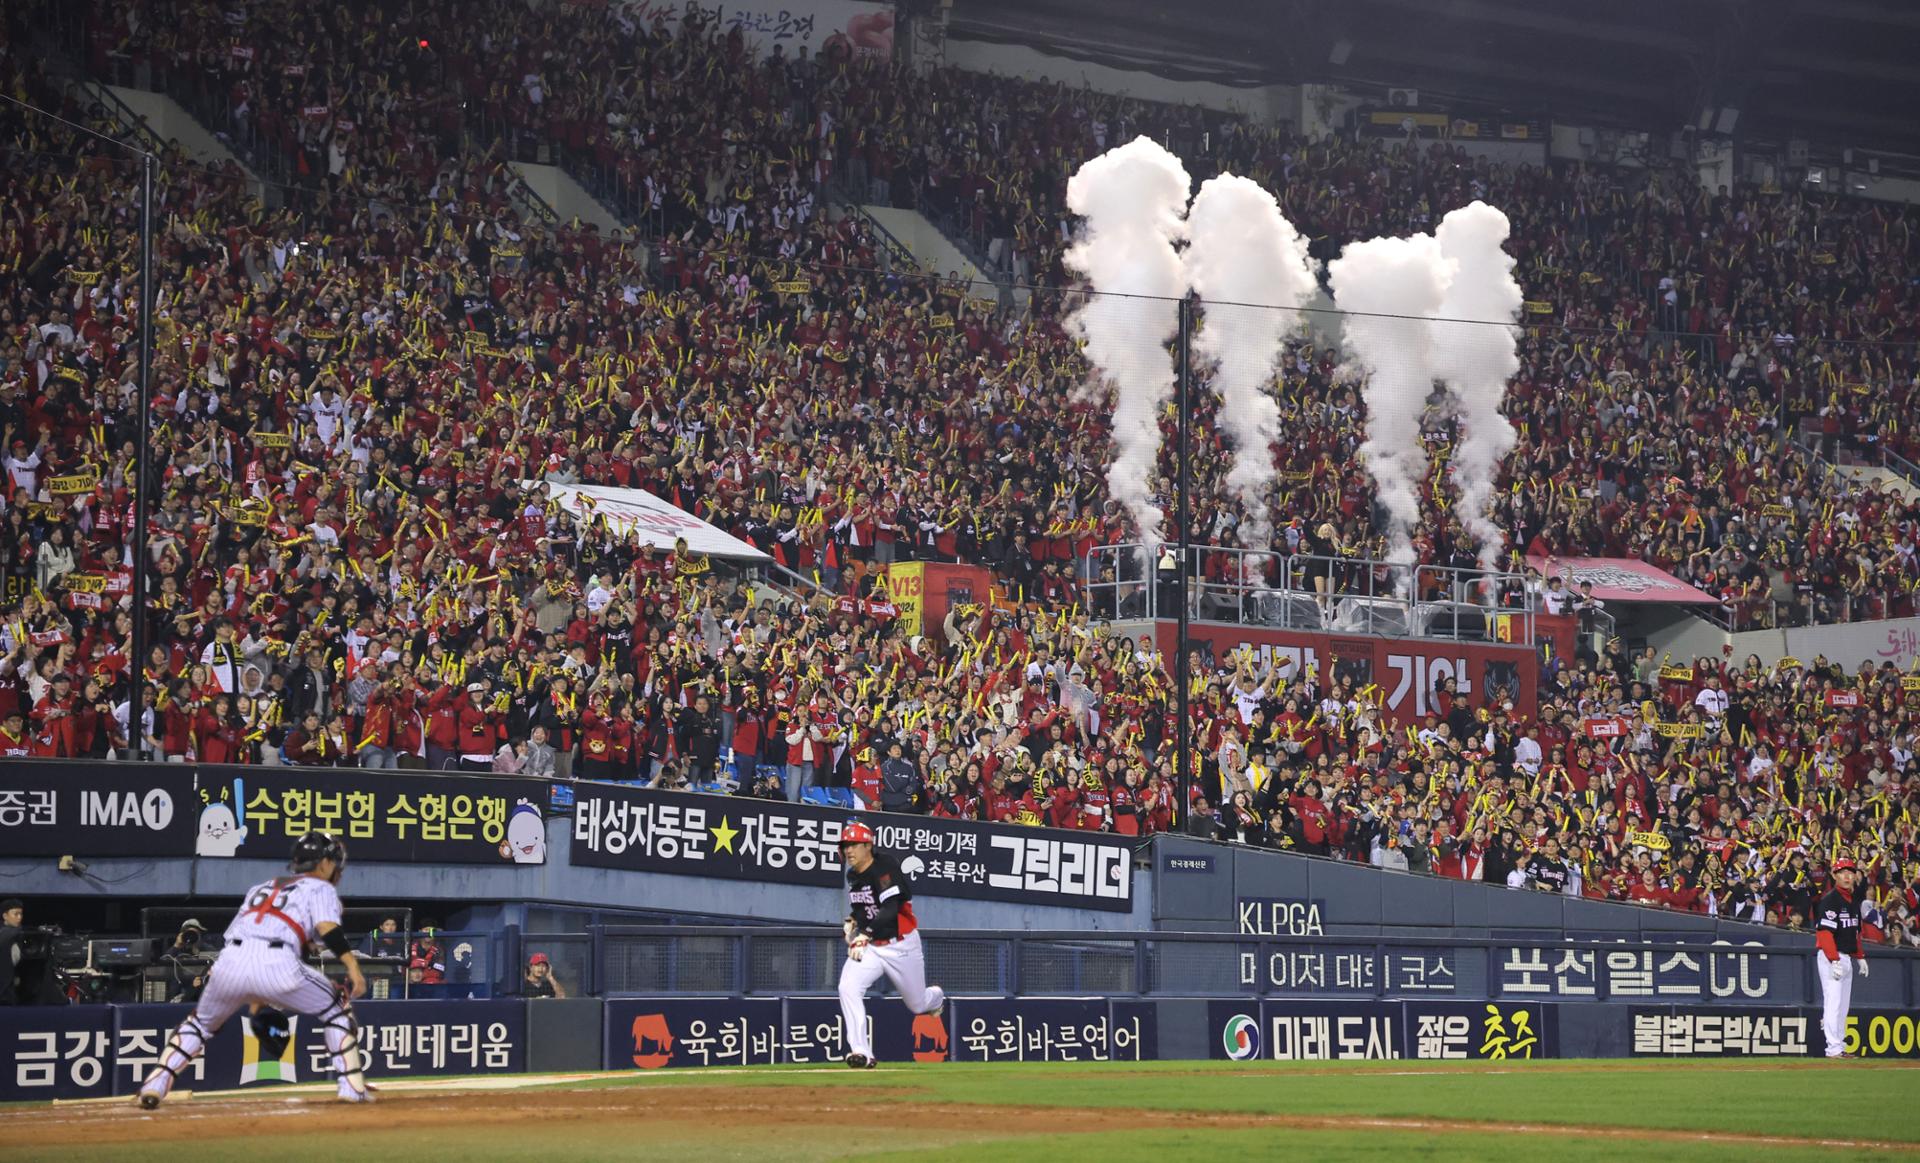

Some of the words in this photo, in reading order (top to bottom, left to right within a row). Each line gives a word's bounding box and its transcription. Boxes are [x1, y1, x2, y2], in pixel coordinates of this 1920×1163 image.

[1789, 398, 1815, 412] 224
[892, 575, 921, 597] V13
[0, 790, 56, 827] 증권
[246, 788, 375, 838] 수협보험
[387, 794, 506, 844] 수협은행
[575, 798, 708, 861] 태성자동문
[738, 813, 843, 872] 자동중문
[915, 829, 943, 853] 원의
[945, 832, 978, 857] 기적
[927, 859, 987, 885] 초록우산
[988, 834, 1131, 899] 그린리더
[1239, 902, 1323, 936] KLPGA
[1400, 955, 1455, 989] 코스
[961, 1015, 1144, 1062] 육회바른연어
[1273, 1017, 1330, 1060] 미래
[1416, 1016, 1470, 1059] 젊은
[1480, 1004, 1538, 1060] 충주
[1634, 1015, 1808, 1054] 불법도박신고
[1844, 1015, 1920, 1057] 5,00
